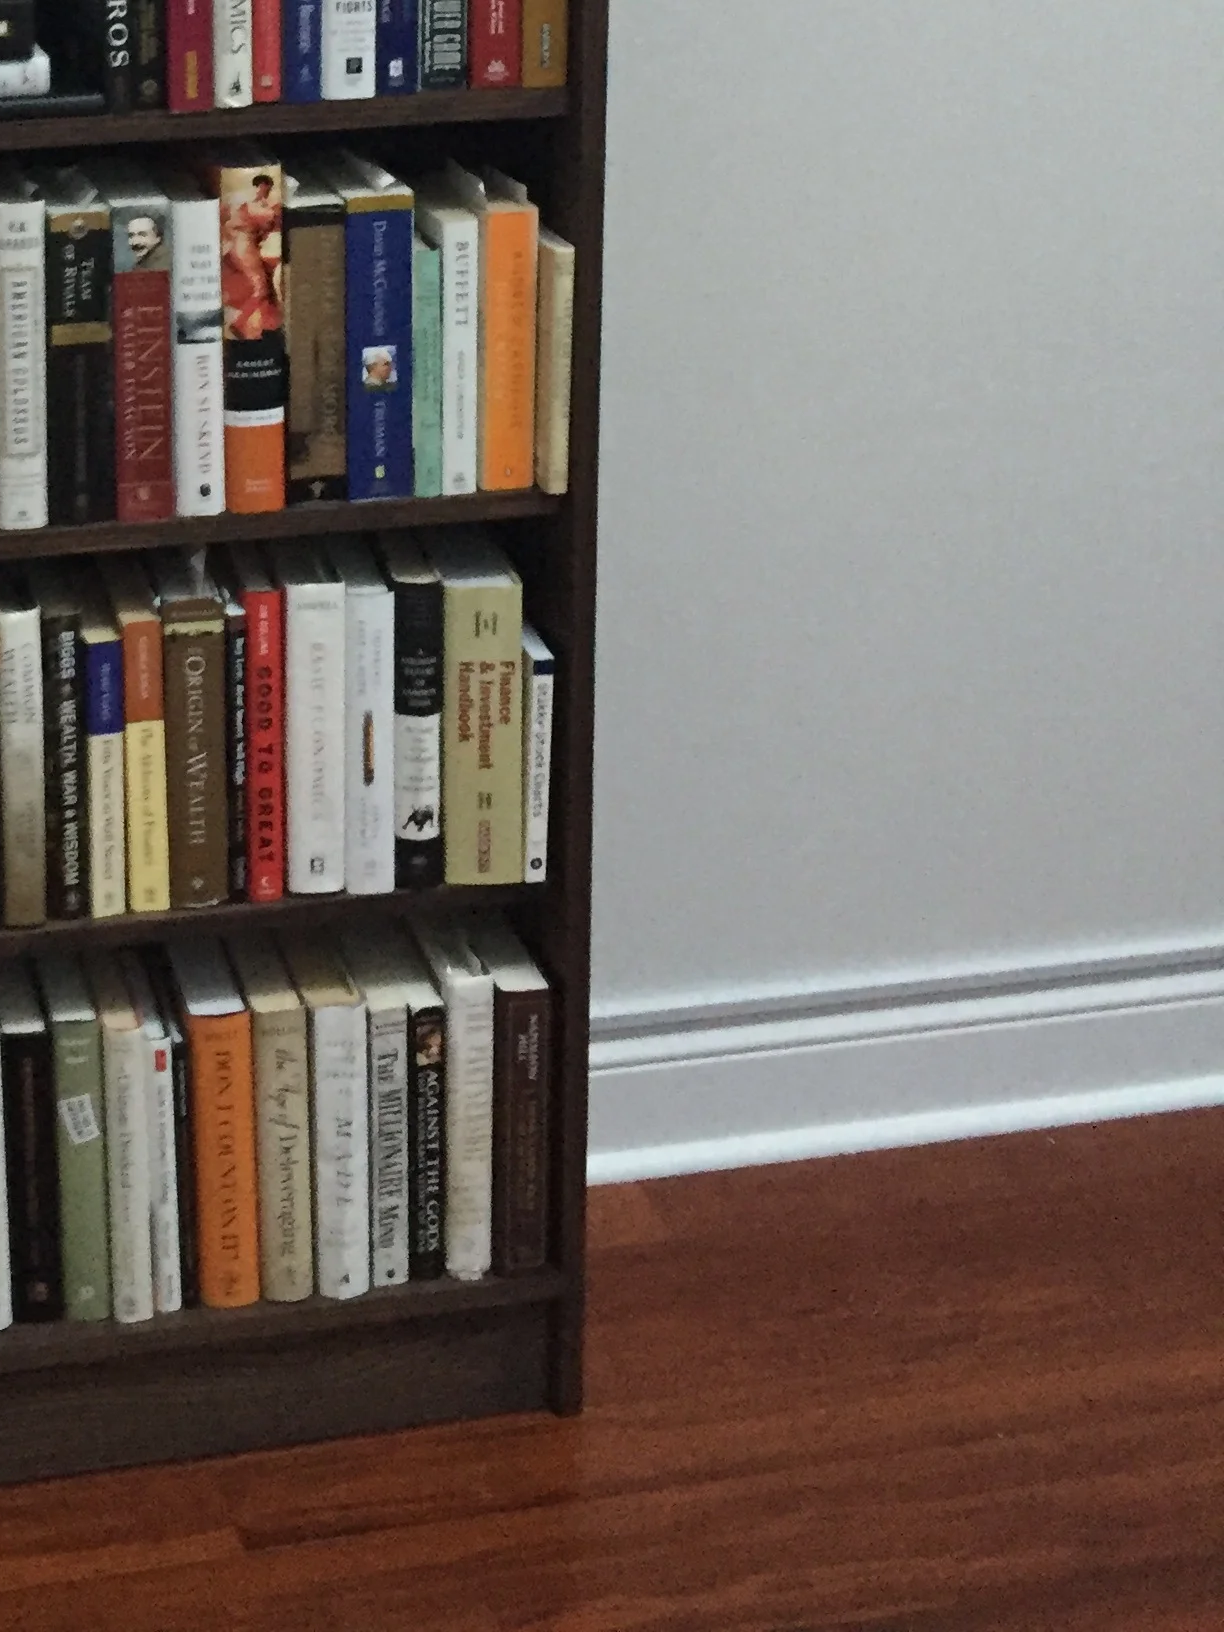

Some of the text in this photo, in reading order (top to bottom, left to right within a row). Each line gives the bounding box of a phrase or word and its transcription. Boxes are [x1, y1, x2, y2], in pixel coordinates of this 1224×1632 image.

[454, 241, 470, 327] BUFFETT
[136, 305, 163, 462] EINSTEIN
[60, 631, 75, 678] BIGGS
[458, 661, 474, 742] Handbook
[499, 661, 515, 725] Finance
[184, 656, 207, 846] ORIGIN WEALTH
[257, 667, 273, 865] GOOD TO GREAT
[478, 661, 493, 770] & Investment
[63, 771, 77, 805] WAR
[64, 822, 79, 885] WISDOM
[276, 1135, 298, 1257] Deleveraging
[378, 1087, 404, 1198] MILLIONAIRE
[426, 1069, 440, 1251] AGAINST THE GODS
